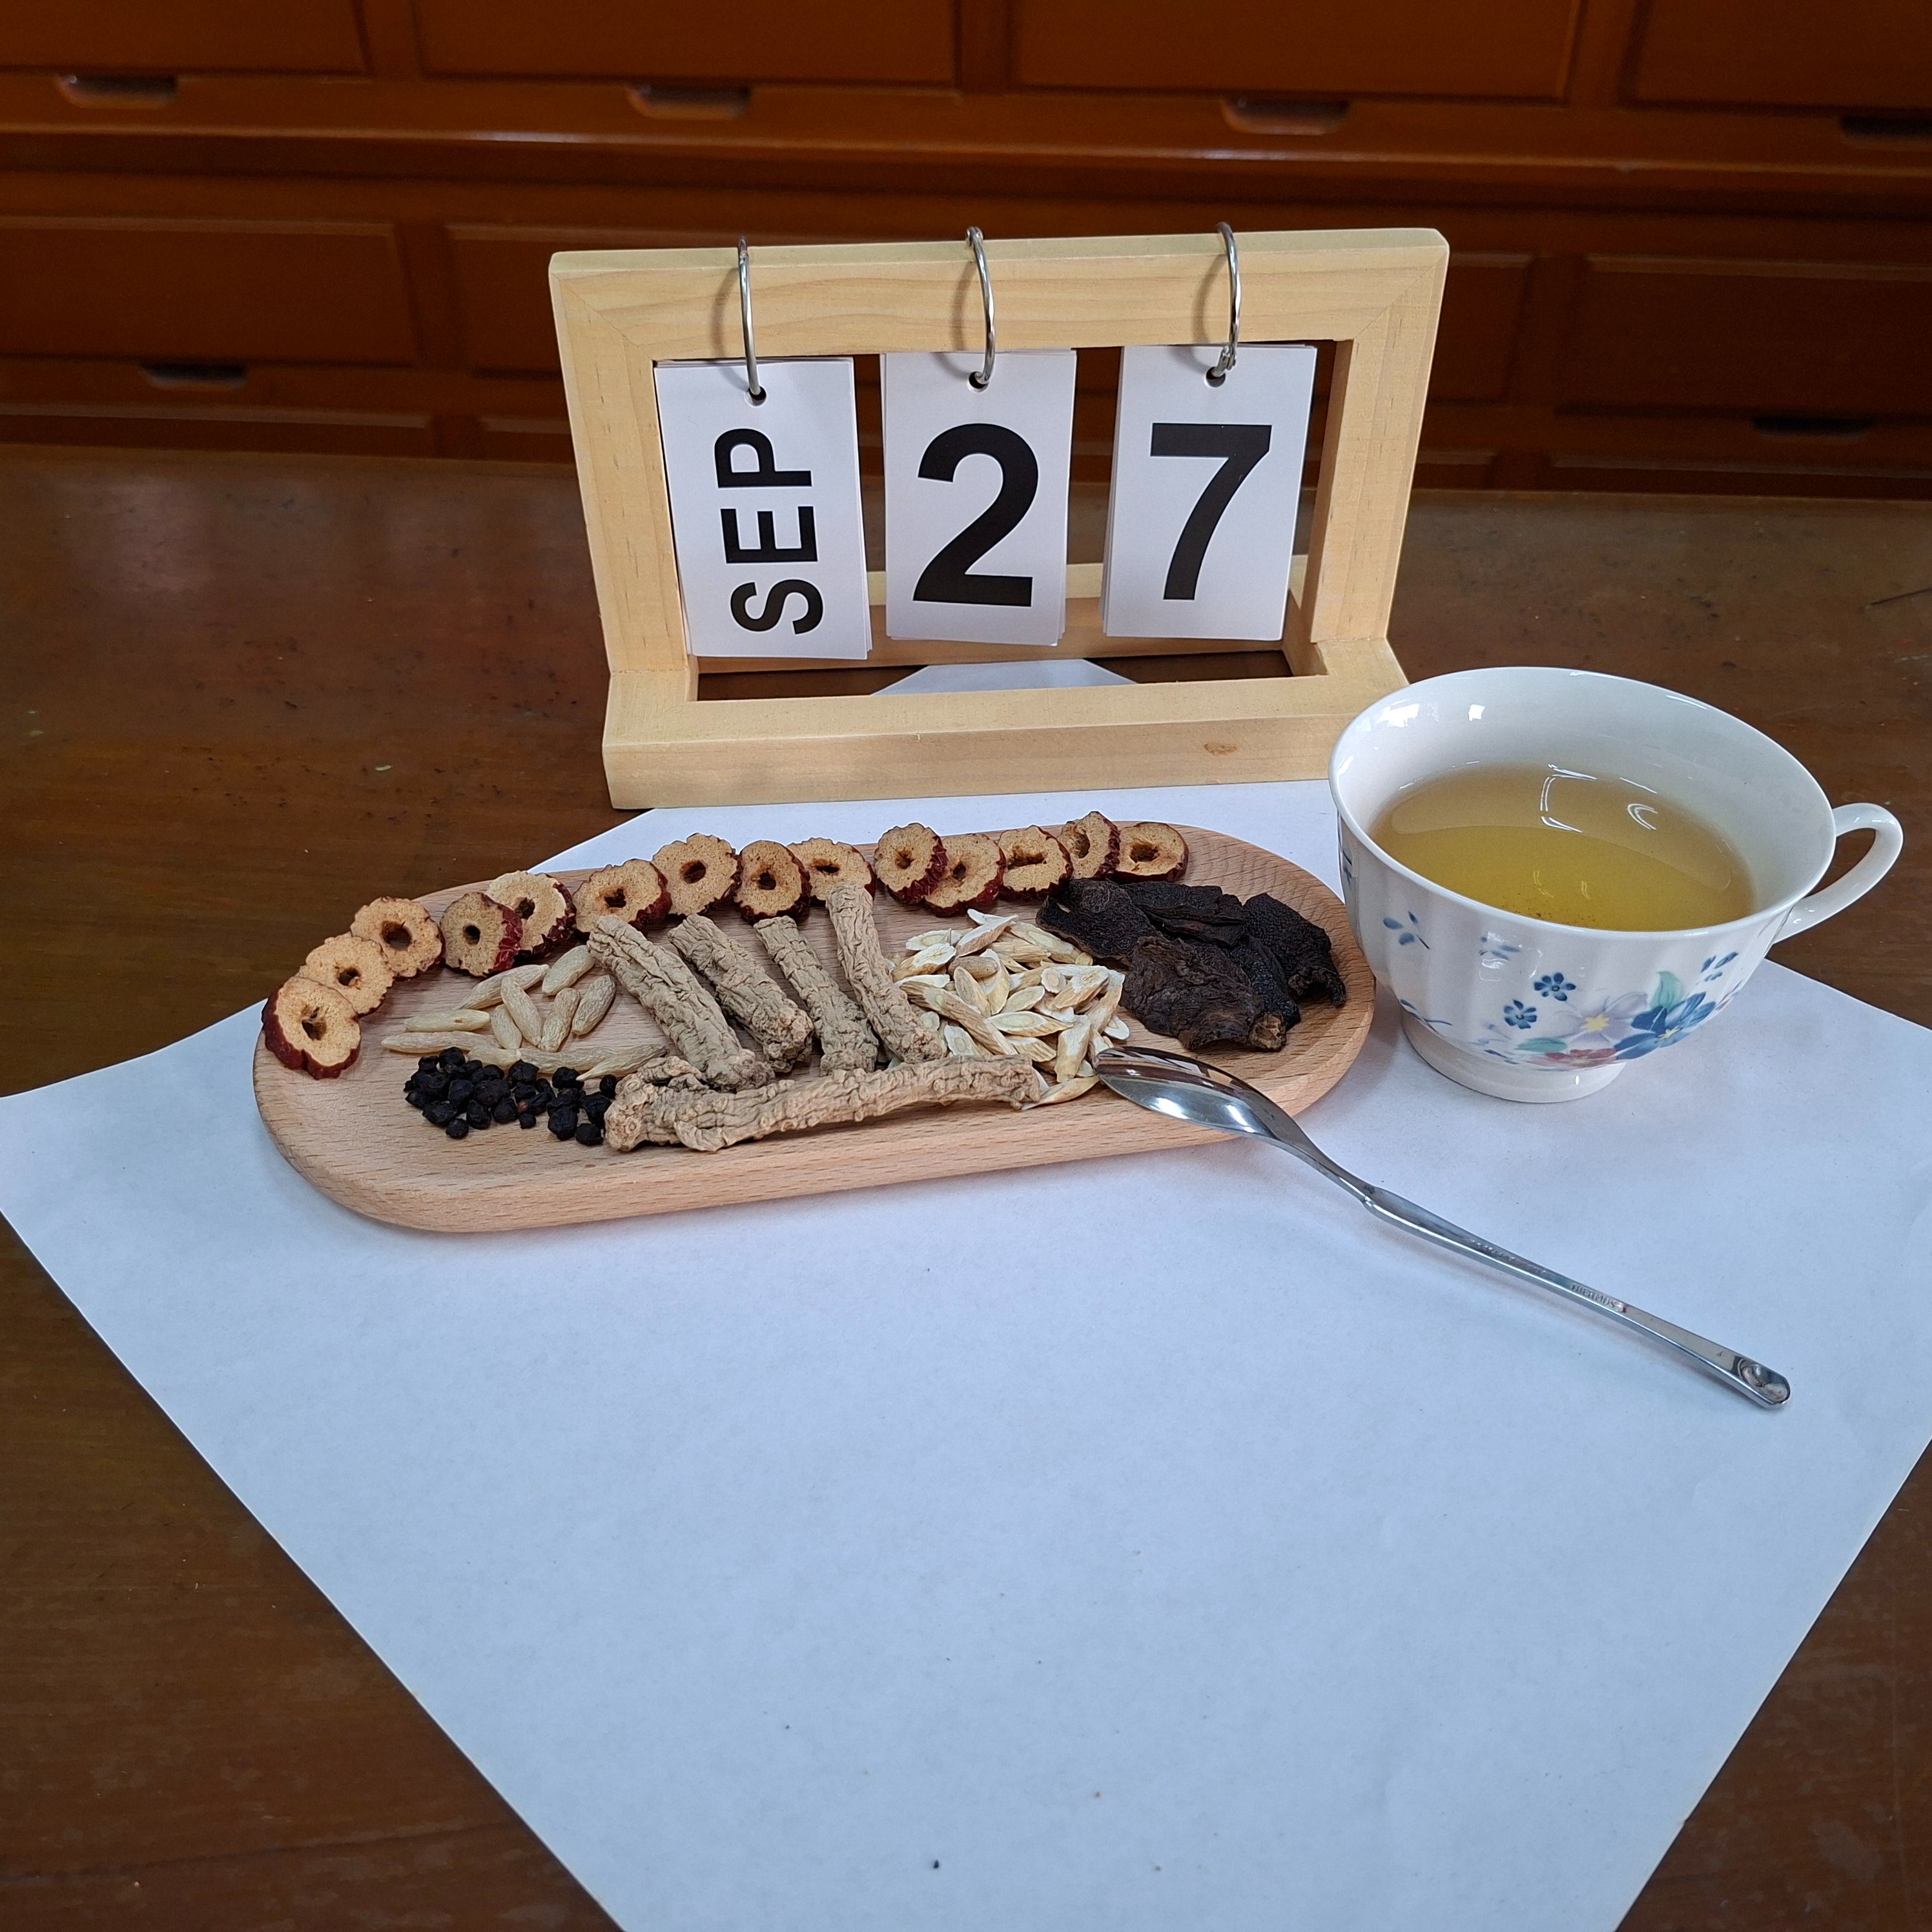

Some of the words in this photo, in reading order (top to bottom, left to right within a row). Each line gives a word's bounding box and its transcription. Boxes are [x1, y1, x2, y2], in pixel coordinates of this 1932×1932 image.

[715, 428, 823, 635] SEP
[912, 423, 1039, 608] 2
[1150, 422, 1272, 601] 7
